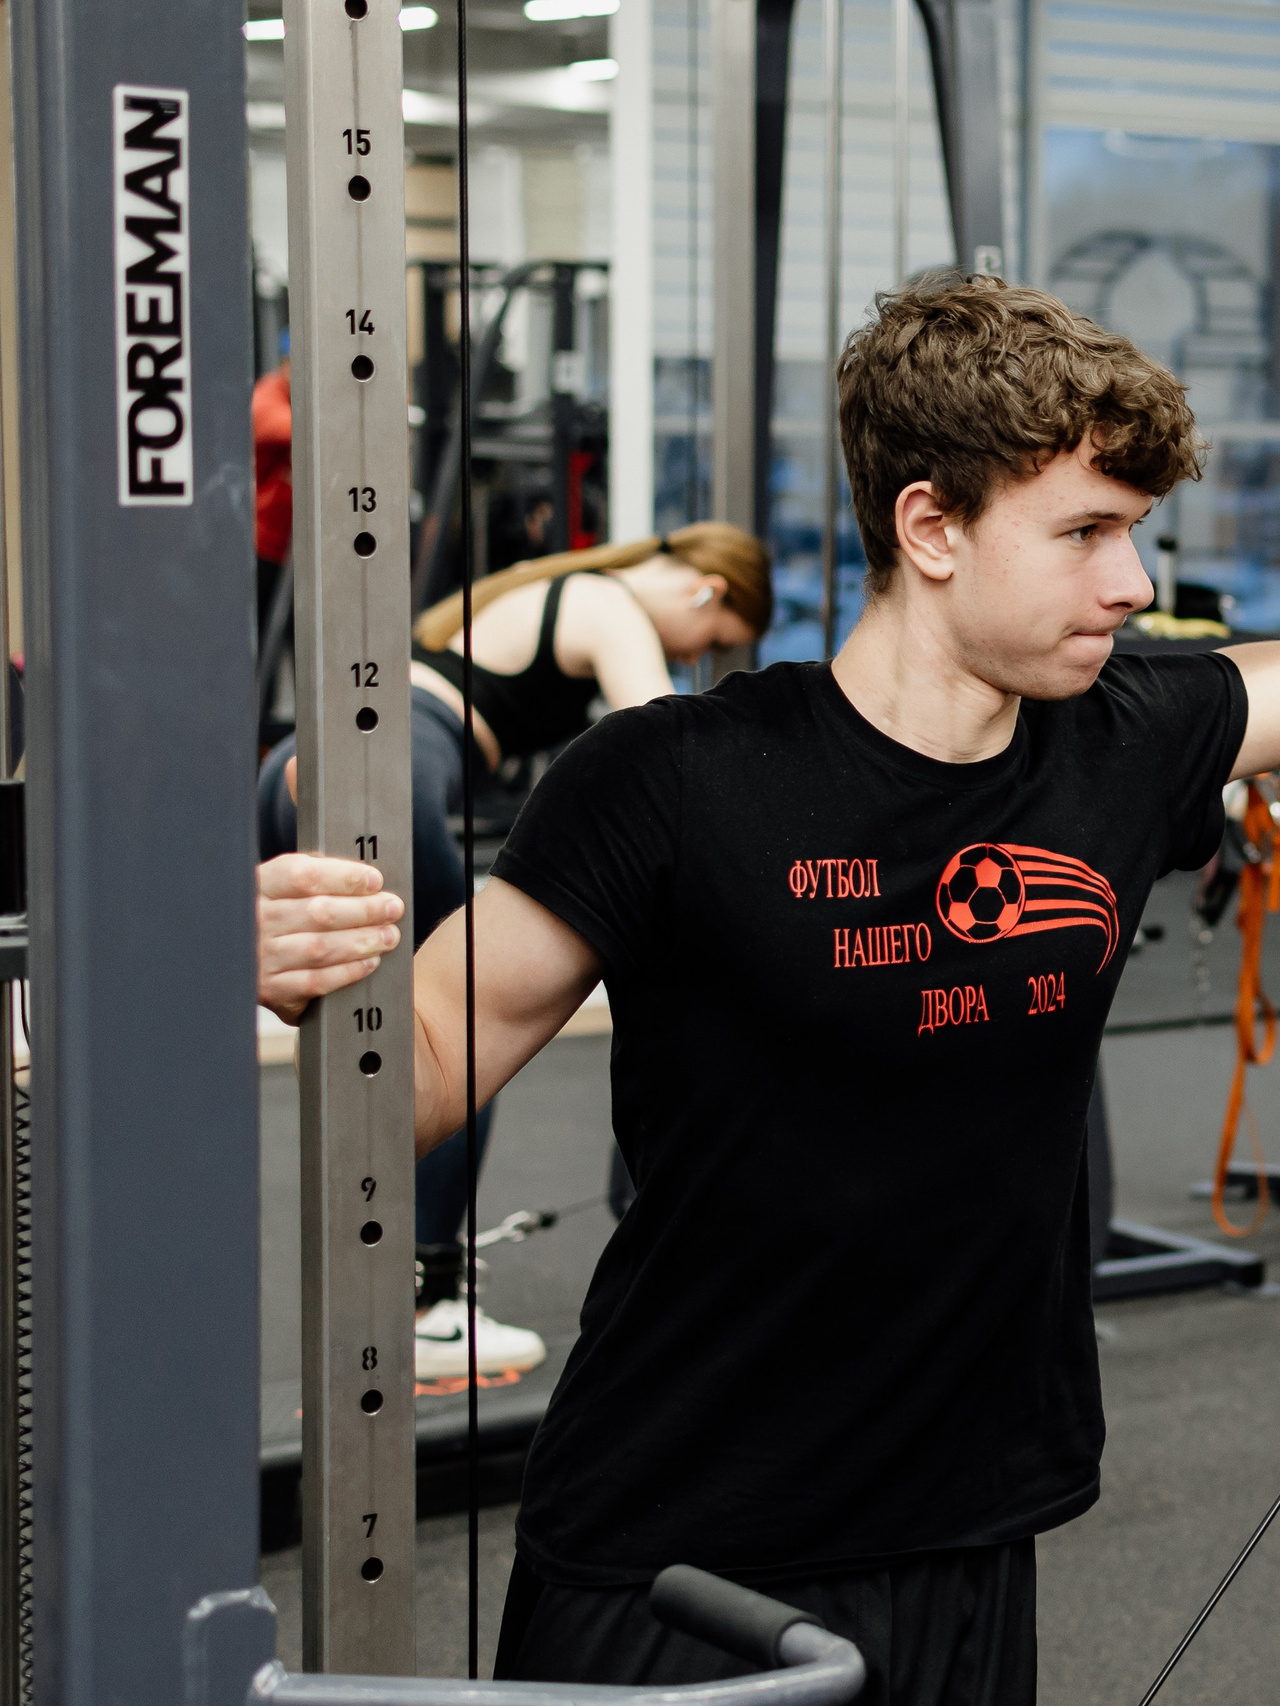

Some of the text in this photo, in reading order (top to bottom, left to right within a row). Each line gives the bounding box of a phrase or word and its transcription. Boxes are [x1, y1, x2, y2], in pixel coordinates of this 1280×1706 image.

[343, 129, 371, 155] 15
[124, 95, 185, 497] FOREMAN
[346, 309, 375, 336] 14
[348, 487, 377, 513] 13
[351, 662, 379, 688] 12
[355, 835, 378, 861] 11
[788, 858, 881, 899] ФУТБОЛ
[834, 922, 932, 968] НАШЕГО
[917, 971, 1067, 1037] ДВОРА 2024
[353, 1007, 383, 1033] 10
[360, 1176, 378, 1203] 9
[361, 1345, 379, 1371] 8
[361, 1513, 379, 1539] 7
